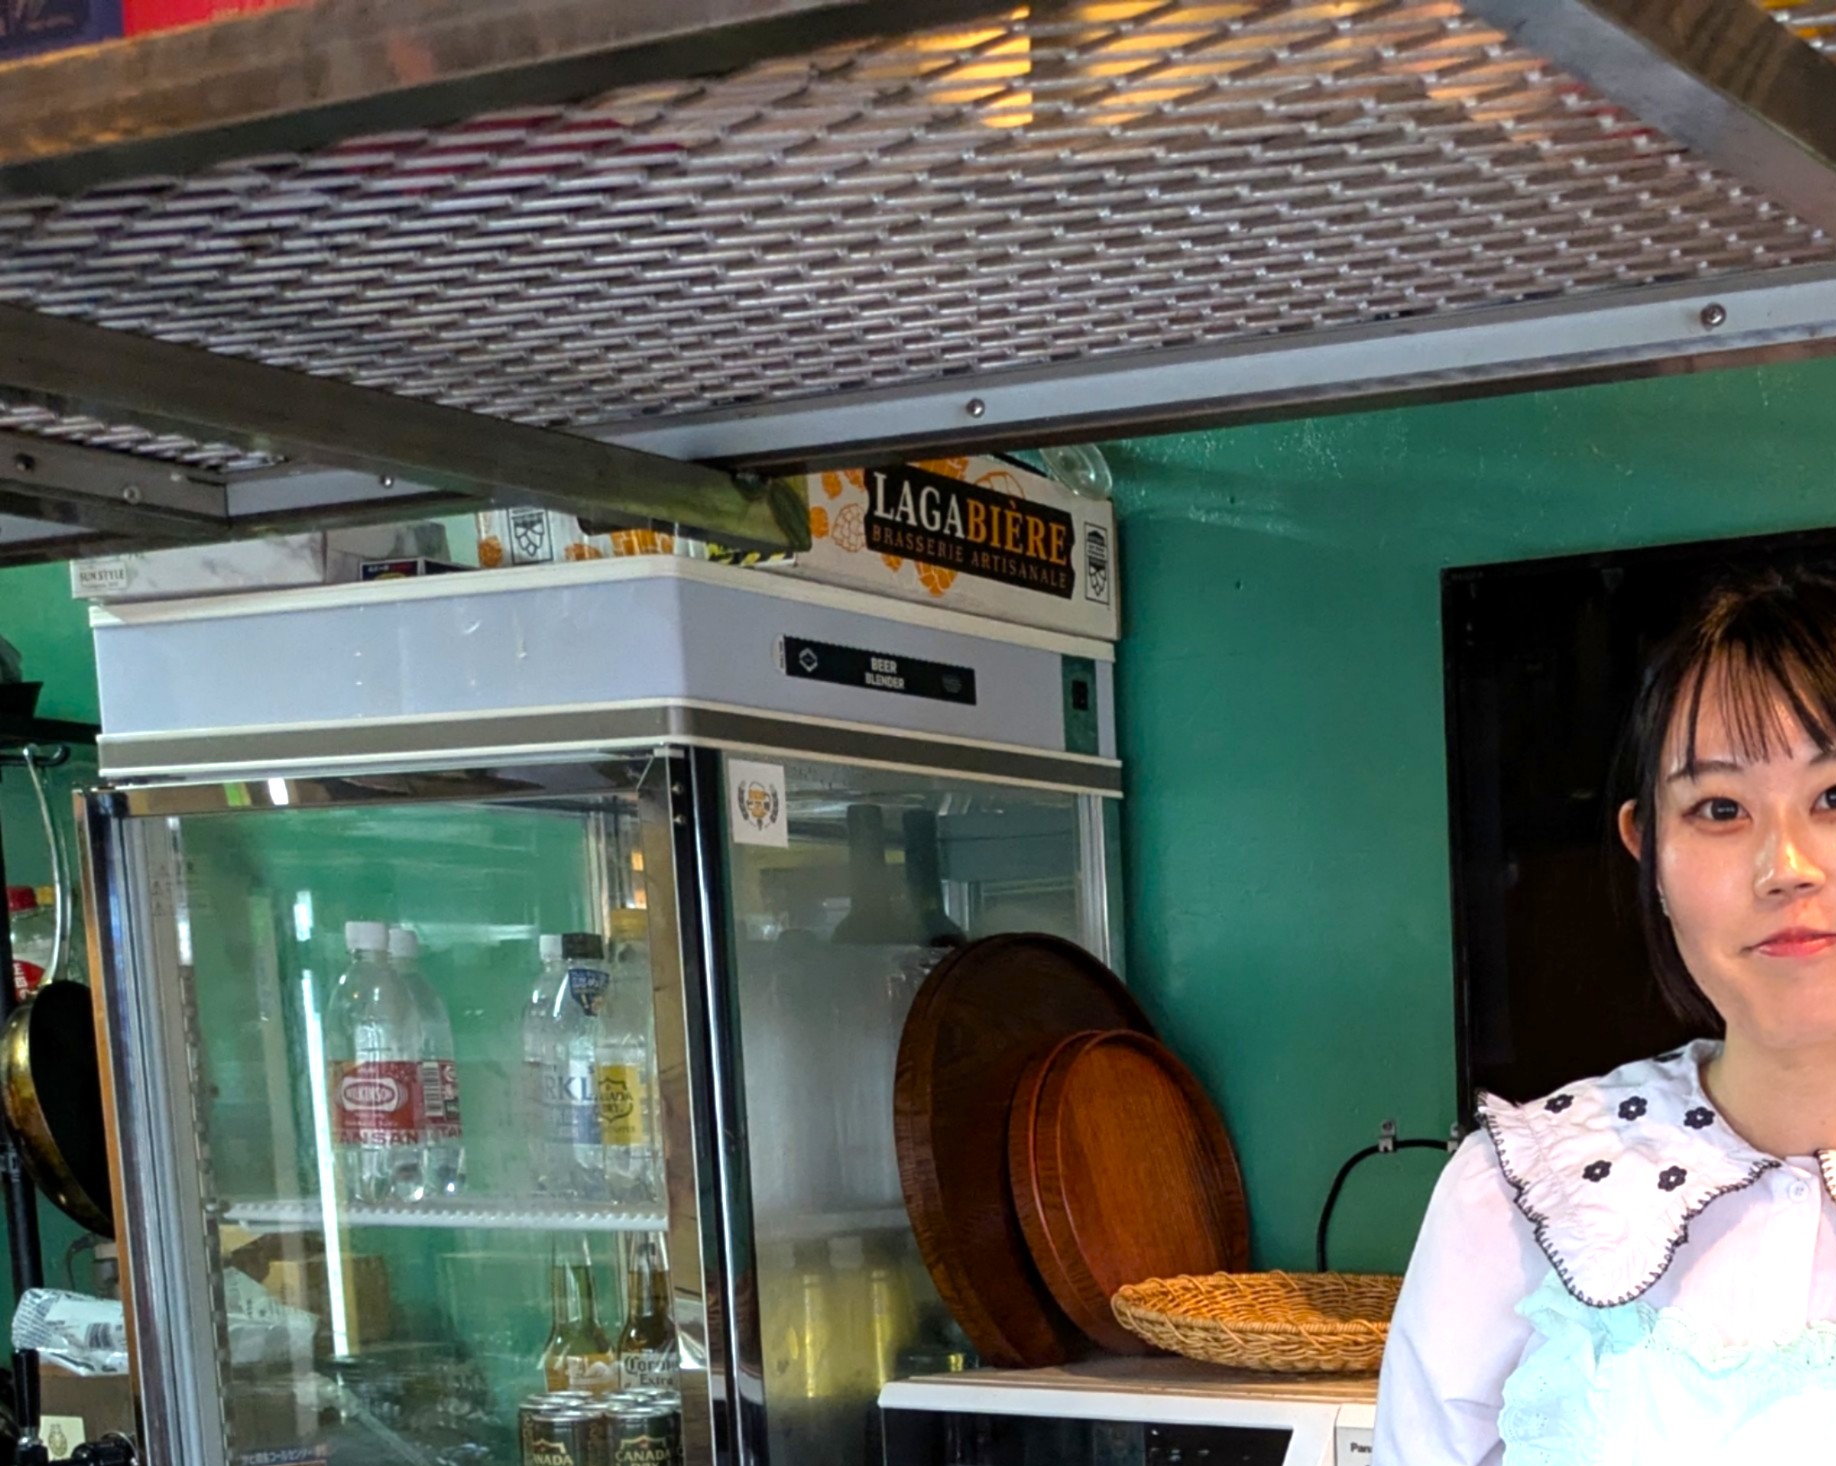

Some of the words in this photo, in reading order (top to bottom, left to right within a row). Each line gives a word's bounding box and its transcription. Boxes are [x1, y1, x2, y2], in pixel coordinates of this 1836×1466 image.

[873, 472, 1068, 566] LAGABIÈRE
[872, 523, 964, 563] BRASSERIE
[971, 552, 1068, 589] ARTISANALE
[870, 657, 898, 673] BEER
[865, 672, 905, 689] BLENDER
[615, 1449, 671, 1462] CANADA
